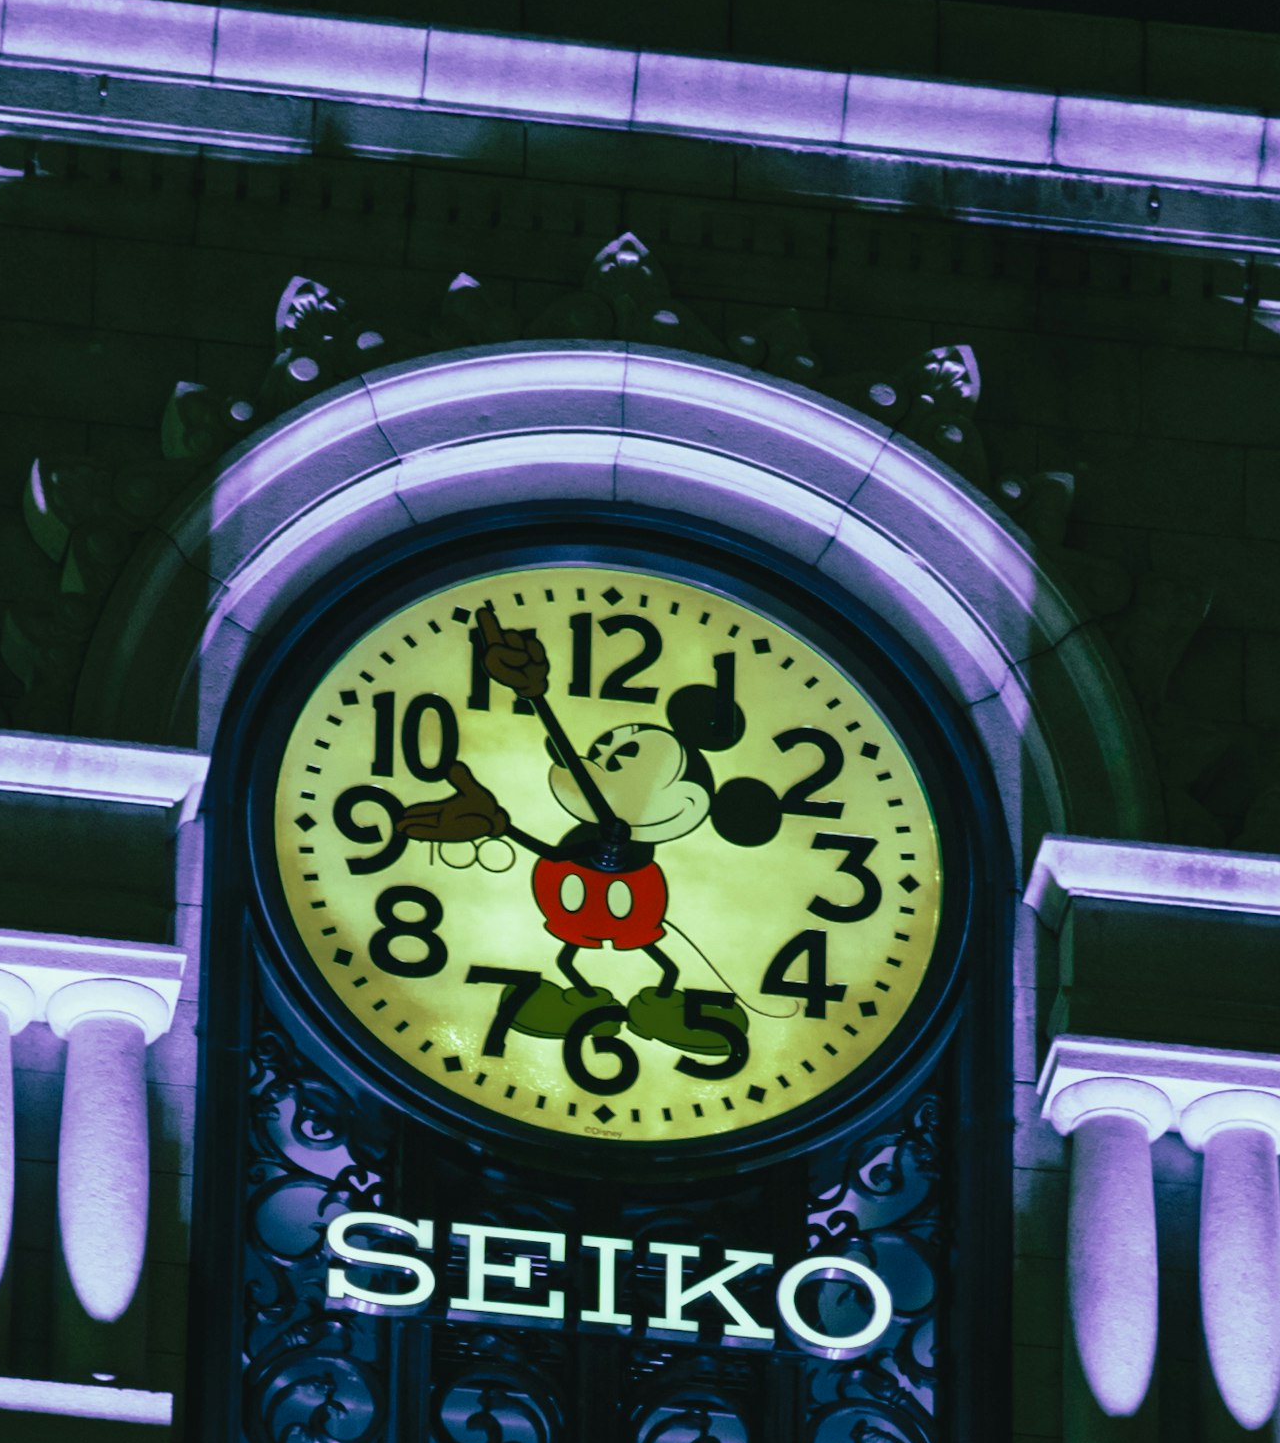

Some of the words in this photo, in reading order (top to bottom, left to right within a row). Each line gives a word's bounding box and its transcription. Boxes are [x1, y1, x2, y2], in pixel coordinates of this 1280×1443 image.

[568, 612, 663, 704] 12
[713, 652, 736, 739] 1
[371, 691, 459, 783] 10
[773, 727, 845, 819] 2
[333, 784, 410, 876] 9
[807, 832, 882, 923] 3
[368, 885, 449, 978] 8
[760, 929, 848, 1019] 4
[464, 965, 542, 1058] 7
[563, 1005, 639, 1096] 6
[674, 988, 750, 1081] 5
[326, 1211, 893, 1350] SEIKO
